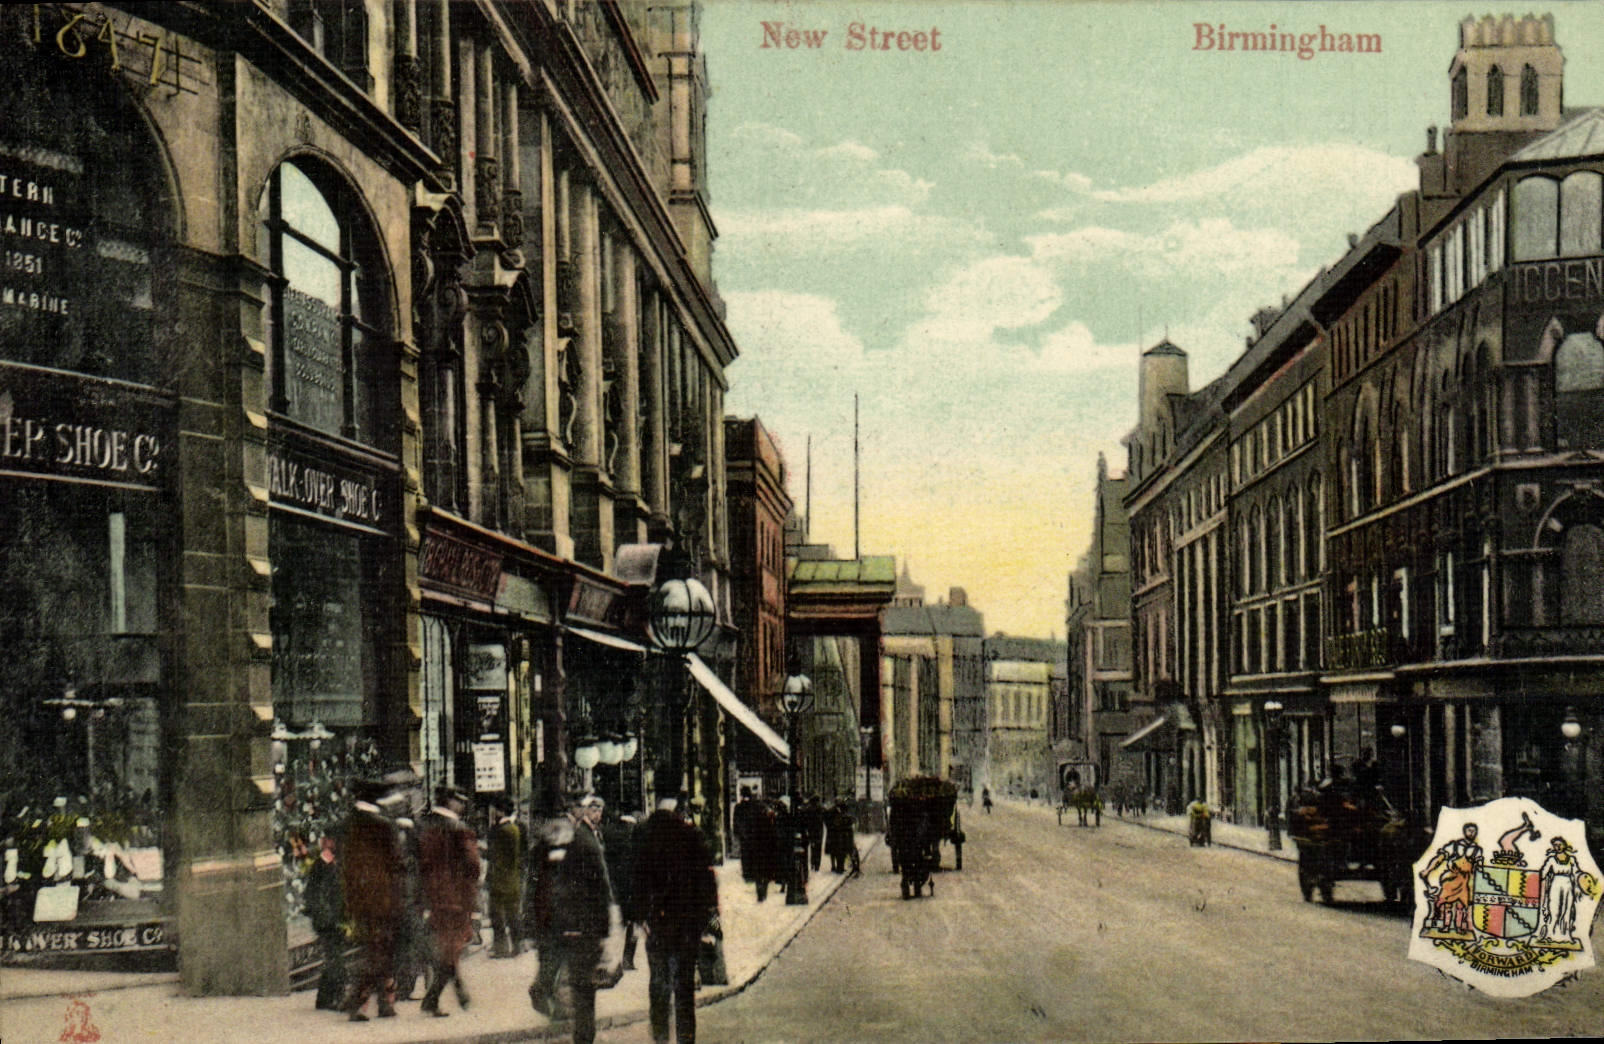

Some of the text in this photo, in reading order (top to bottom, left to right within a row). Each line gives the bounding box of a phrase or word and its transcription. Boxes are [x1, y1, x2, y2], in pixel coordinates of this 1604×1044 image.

[0, 213, 60, 243] ANCE
[55, 423, 129, 472] SHOE
[340, 478, 369, 520] SHOE
[87, 927, 138, 949] SHOE
